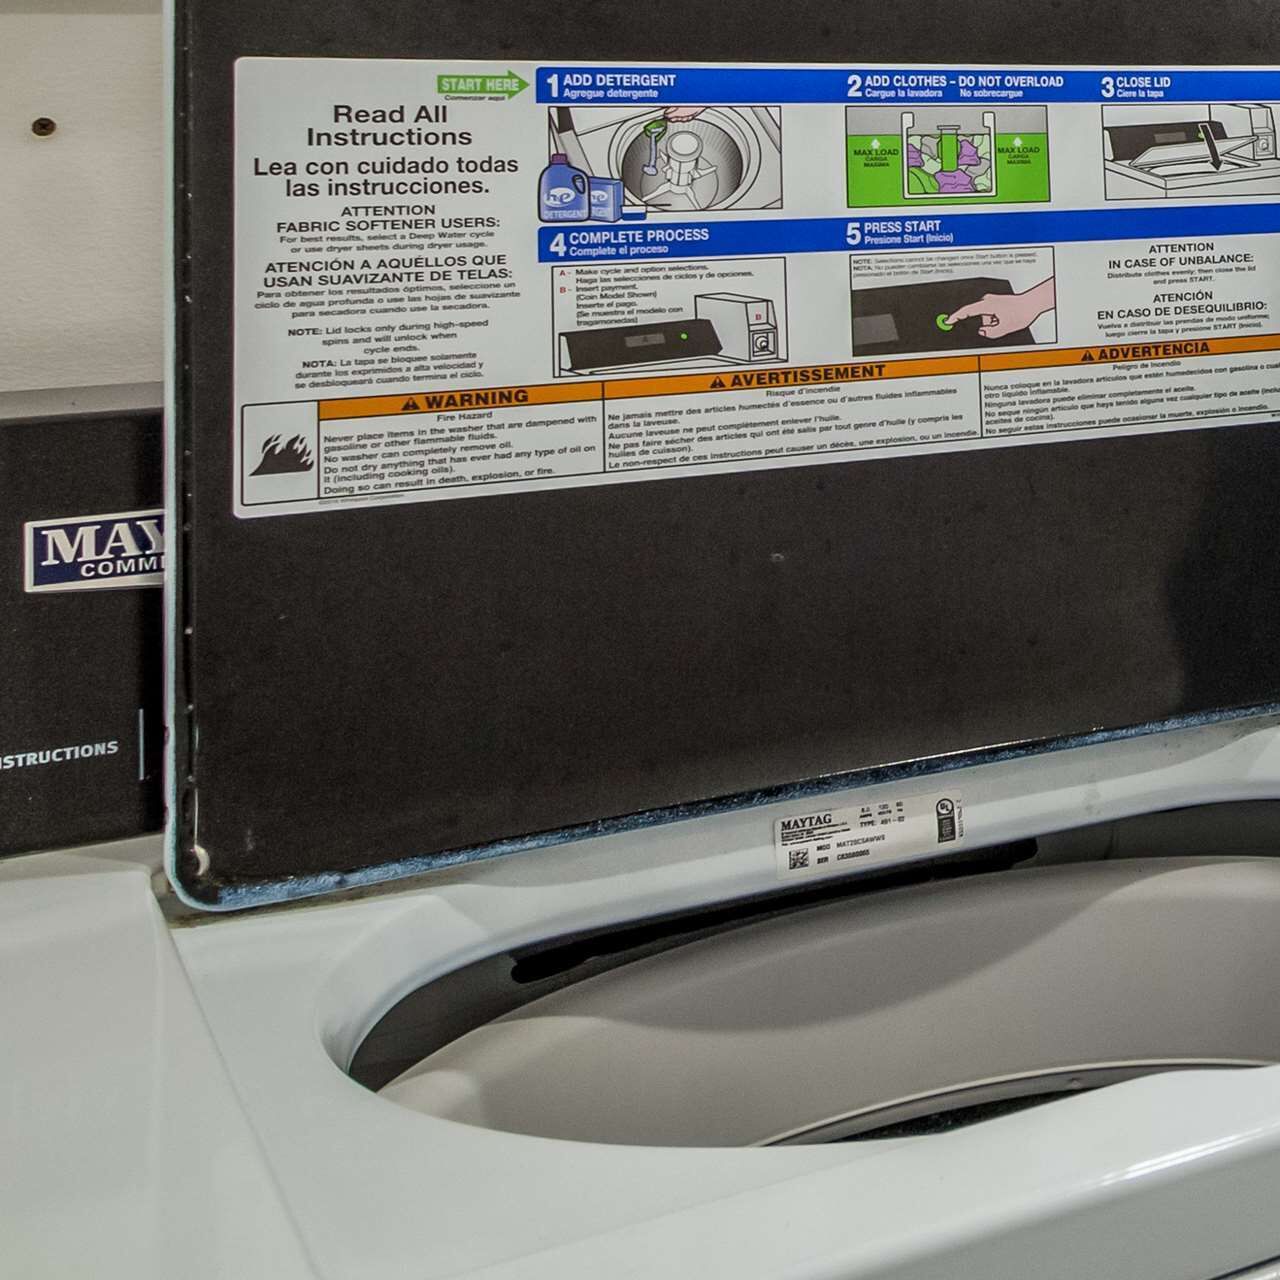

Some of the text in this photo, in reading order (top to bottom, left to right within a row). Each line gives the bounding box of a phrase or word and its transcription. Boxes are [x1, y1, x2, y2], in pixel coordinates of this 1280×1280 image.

[442, 78, 520, 91] START HERE
[546, 74, 676, 98] 1 ADD DETERGENT
[847, 75, 1064, 97] 2 ADD CLOTHES DO NOT OVERLOAD
[1101, 76, 1171, 97] 3 CLOSE LID
[564, 88, 658, 99] Agregue detergente
[865, 89, 943, 98] Cargue la lavadora
[960, 89, 1023, 98] No sobrecargue
[1147, 91, 1164, 99] tapa
[334, 105, 447, 123] Read All
[307, 128, 472, 146] Instructions
[254, 156, 519, 176] Lea con cuidado todas
[286, 178, 490, 196] las instrucciones.
[341, 205, 435, 217] ATTENTION
[277, 217, 500, 233] FABRIC SOFTENER USERS:
[846, 220, 941, 245] 5 PRESS START
[326, 234, 363, 242] results,
[367, 232, 397, 241] select
[409, 232, 435, 242] Deep
[438, 231, 466, 239] Water
[470, 230, 494, 239] cycle
[549, 229, 710, 257] 4 COMPLETE PROCESS
[864, 233, 954, 244] Presione Start (Inicio)
[569, 245, 669, 258] Complete el proceso
[1149, 242, 1214, 254] ATTENTION
[265, 255, 506, 273] ATENCIÓN A AQUÉLLOS QUE
[1109, 254, 1254, 269] IN CASE OF UNBALANCE:
[264, 269, 512, 288] USAN SUAVIZANTE DE TELAS:
[1153, 289, 1213, 303] ATENCIÓN
[1098, 301, 1267, 320] EN CASO DE DESEQUILIBRIO:
[288, 319, 488, 336] NOTE: Lid locks only during high-speed
[1099, 341, 1210, 360] ADVERTENCIA
[1113, 363, 1138, 371] Peligro
[1151, 360, 1181, 368] Incendio
[730, 365, 886, 388] AVERTISSEMENT
[424, 390, 528, 410] WARNING
[766, 390, 794, 399] Risque
[437, 411, 493, 423] Fire Hazard
[41, 519, 165, 565] MAY
[80, 556, 165, 577] COMM
[781, 814, 832, 831] MAYTAG
